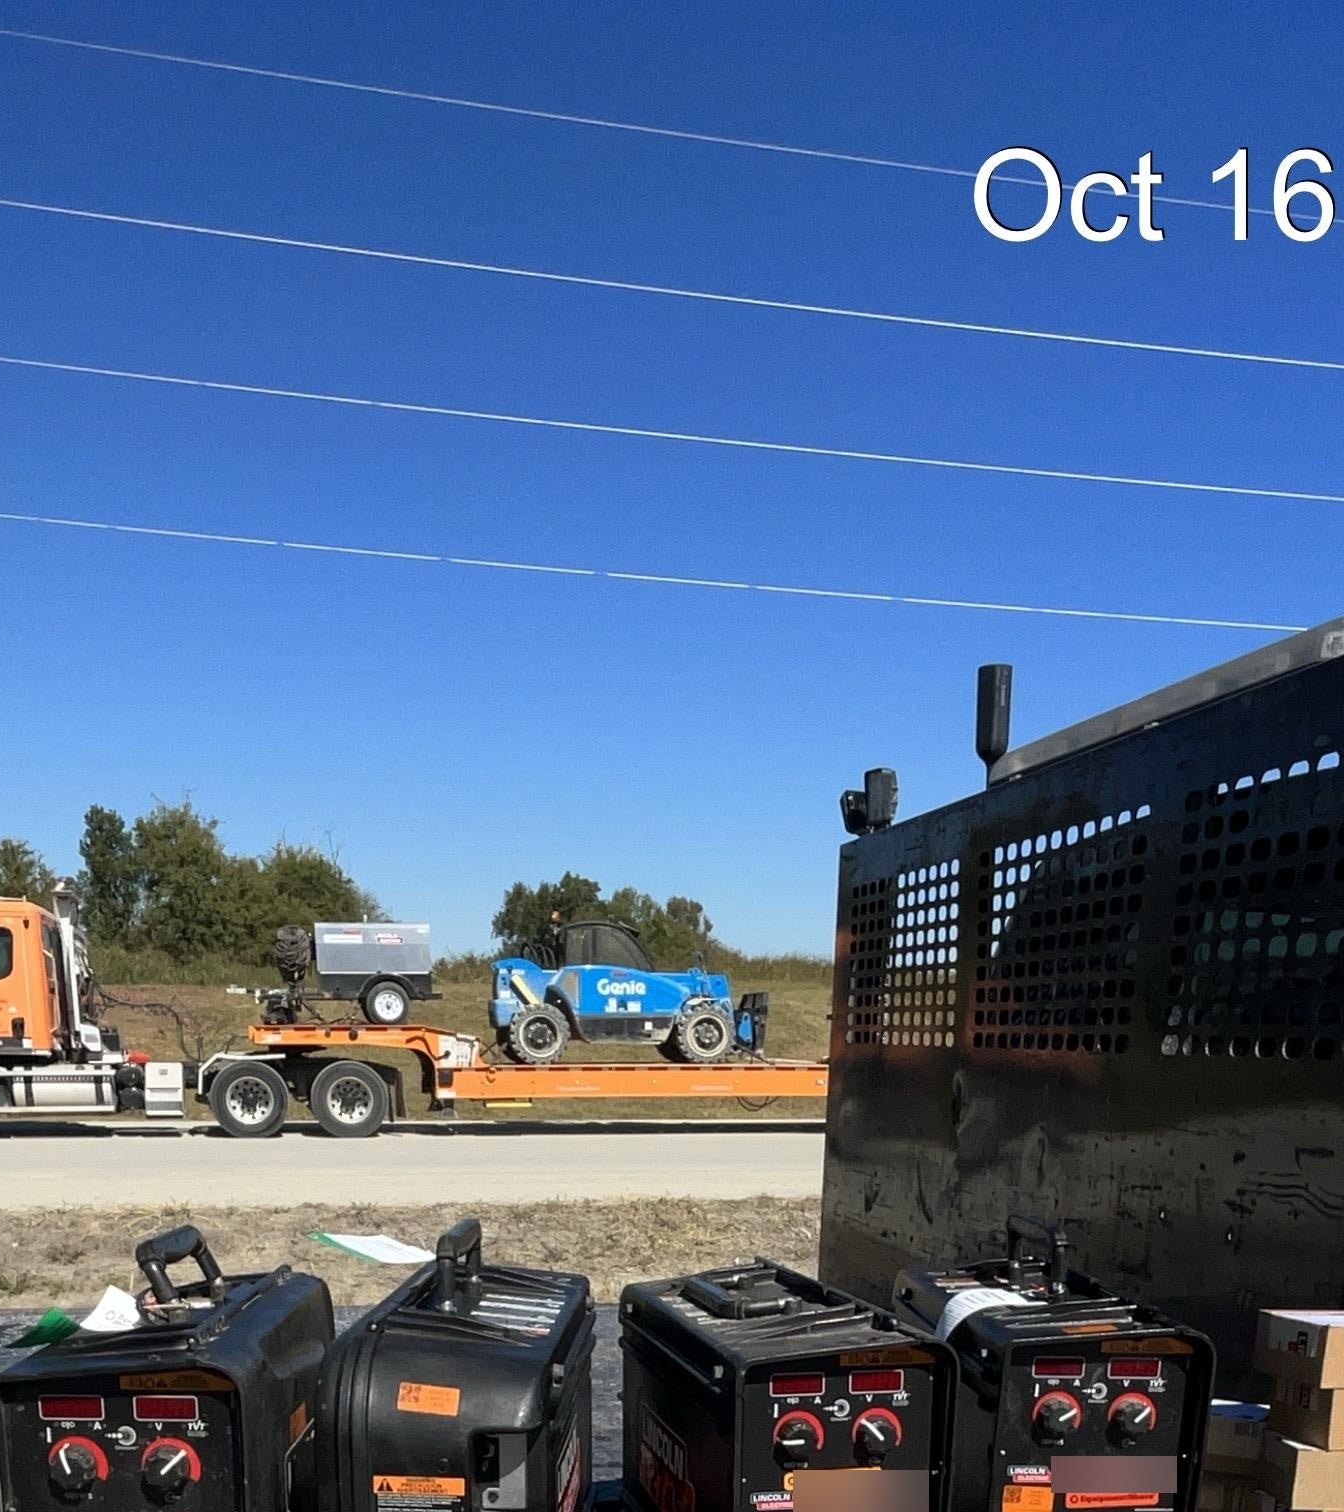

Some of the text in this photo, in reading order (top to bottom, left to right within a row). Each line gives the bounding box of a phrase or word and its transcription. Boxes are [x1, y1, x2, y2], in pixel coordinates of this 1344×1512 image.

[597, 978, 646, 995] Genie
[1009, 1467, 1047, 1475] LINCOLN
[752, 1493, 791, 1502] LINCOLN
